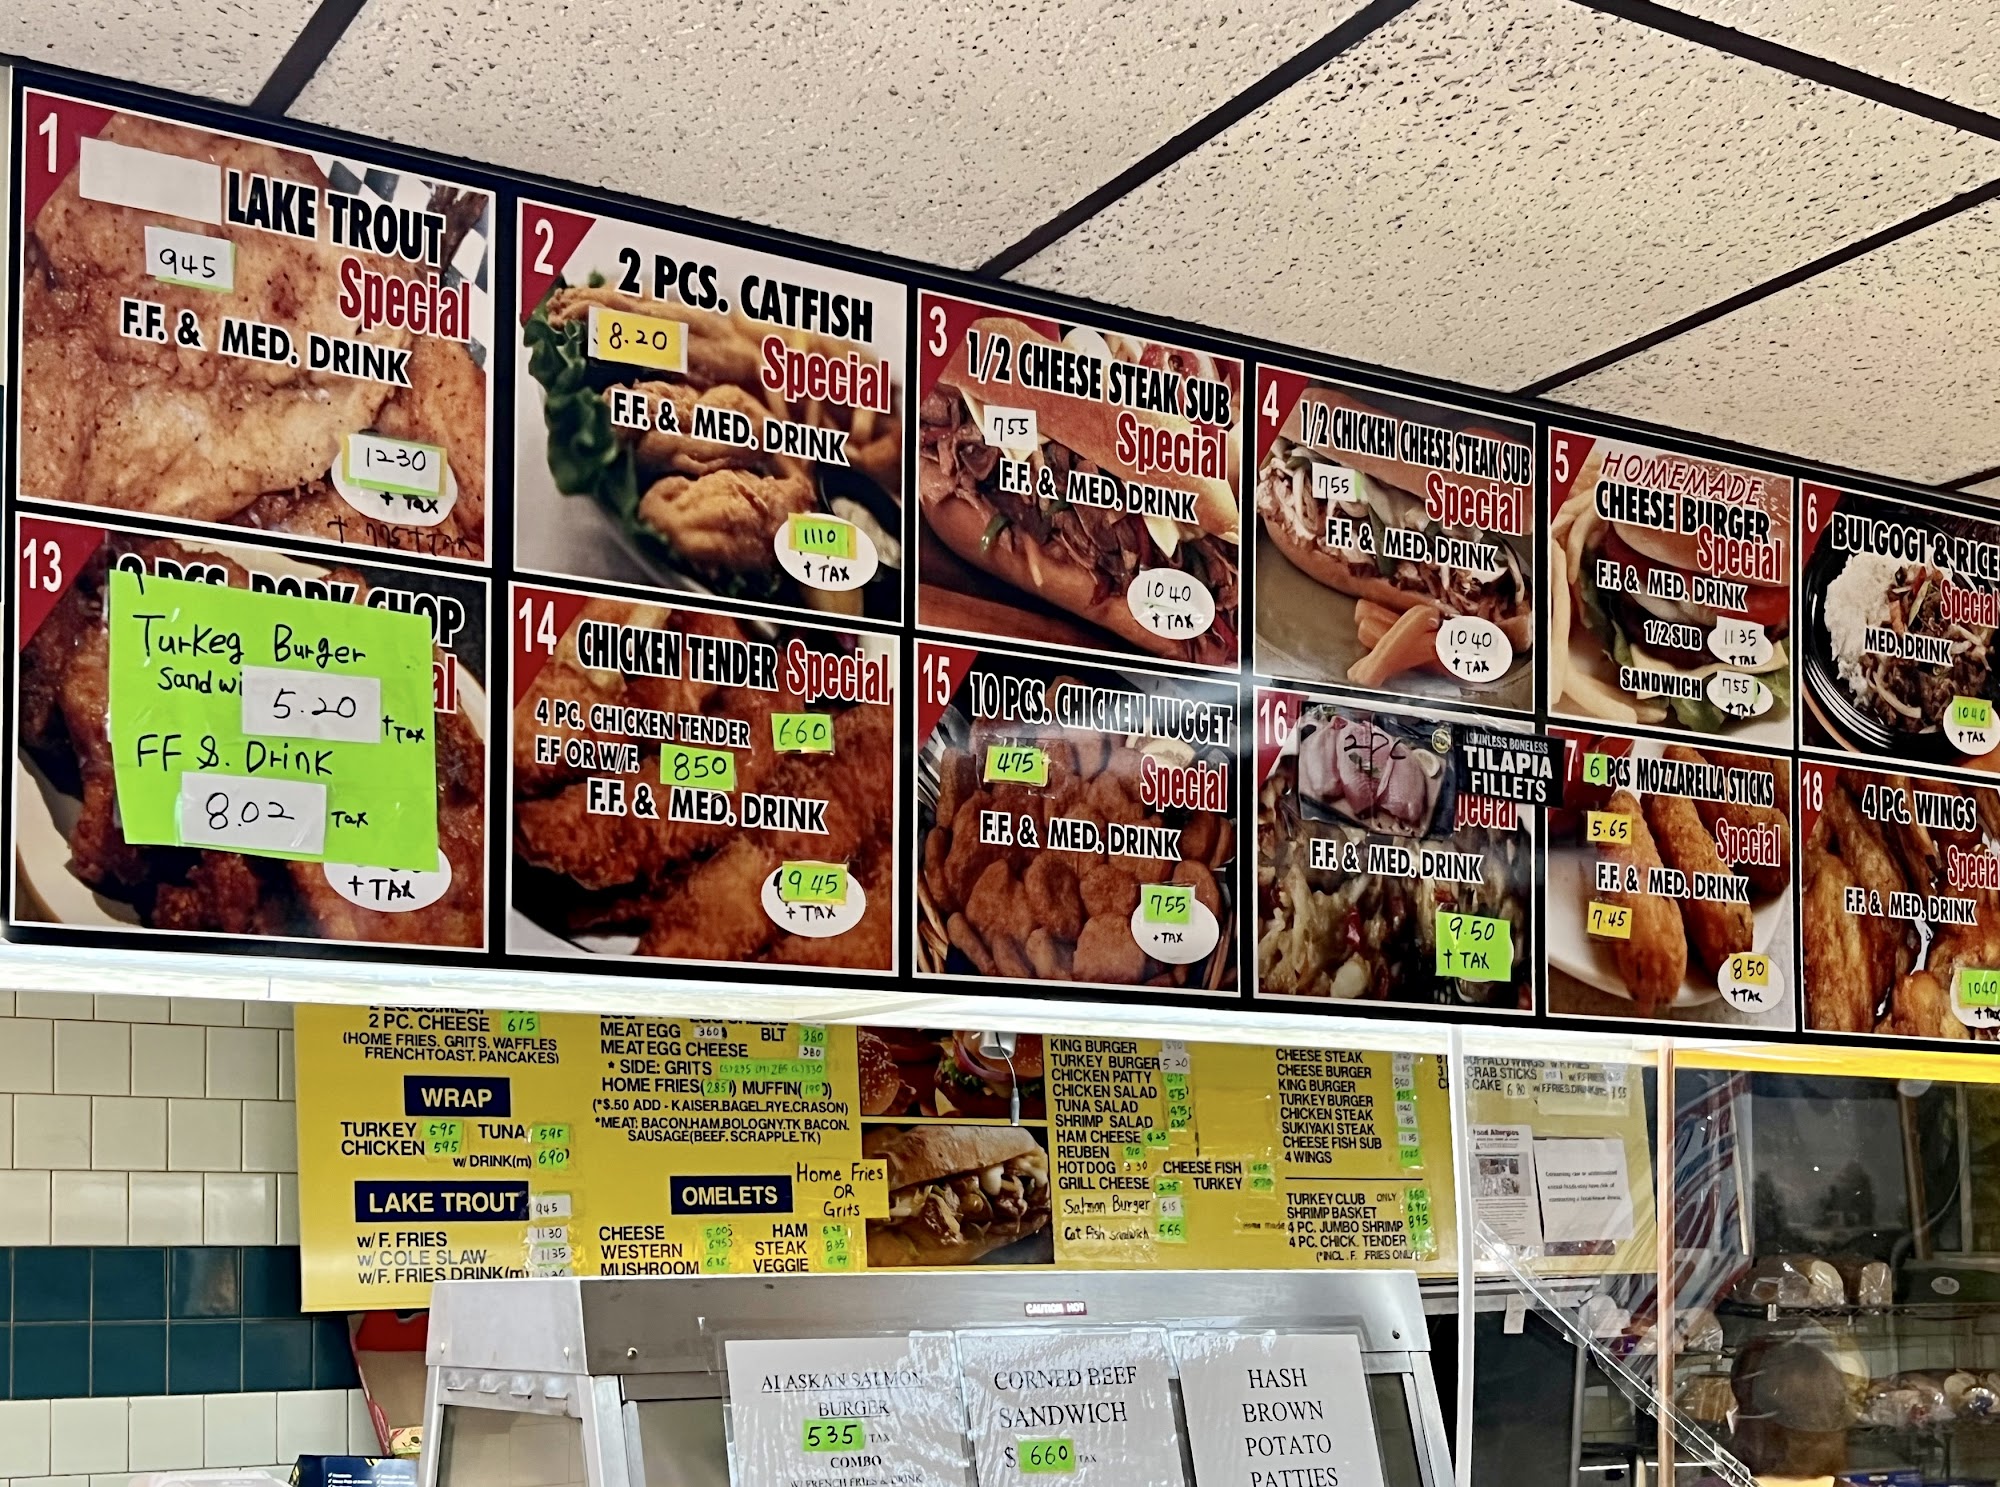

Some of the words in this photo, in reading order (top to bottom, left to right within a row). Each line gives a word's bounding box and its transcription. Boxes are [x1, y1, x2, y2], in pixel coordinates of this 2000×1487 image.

[39, 113, 57, 173] 1
[228, 171, 317, 239] LAKE
[326, 190, 445, 265] TROUT
[534, 219, 554, 276] 2
[160, 248, 216, 278] 945
[340, 258, 471, 341] Special
[619, 247, 641, 294] 2
[655, 254, 728, 312] PCS.
[741, 275, 873, 343] CATFISH
[610, 322, 667, 350] 8.20
[929, 306, 948, 358] 3
[221, 320, 299, 365] MED.
[311, 336, 412, 387] DRINK
[763, 338, 891, 413] Special
[967, 331, 1012, 384] 1/2
[1018, 342, 1102, 400] CHEESE
[1109, 360, 1181, 415] STEAK
[1185, 377, 1231, 425] SUB
[1262, 380, 1279, 427] 4
[1117, 413, 1228, 480] Special
[1300, 401, 1329, 448] 1/2
[1332, 407, 1397, 461] CHICKEN
[1400, 422, 1452, 470] CHEESE
[1454, 431, 1500, 480] STEAK
[1502, 442, 1532, 486] SUB
[366, 446, 427, 471] 1230
[1554, 440, 1569, 483] 5
[1601, 451, 1766, 506] HOMEMADE
[1596, 481, 1675, 531] CHEESE
[1681, 497, 1770, 545] BURGER
[1807, 492, 1818, 533] 6
[803, 527, 836, 546] 1110
[1832, 512, 1927, 563] BULGOGI
[1932, 533, 1951, 570] &
[1954, 537, 2000, 581] RICE
[1697, 524, 1782, 584] Special
[22, 540, 63, 594] 13
[1940, 578, 2000, 629] Special
[518, 597, 558, 656] 14
[1644, 620, 1670, 647] 1/2
[1671, 626, 1702, 652] SUB
[273, 624, 367, 669] Burger
[1864, 627, 1902, 659] MED.
[1903, 633, 1953, 667] DRINK
[578, 621, 682, 679] CHICKEN
[687, 637, 778, 692] TENDER
[786, 638, 891, 704] Special
[922, 653, 950, 706] 15
[1620, 666, 1703, 701] SANDWICH
[272, 689, 357, 721] 5.20
[970, 672, 1000, 719] 10
[1003, 677, 1051, 725] PCS.
[1056, 683, 1146, 735] CHICKEN
[1149, 695, 1233, 747] NUGGET
[535, 698, 549, 725] 4
[553, 702, 585, 730] PC.
[590, 706, 674, 741] CHICKEN
[678, 715, 751, 748] TENDER
[777, 720, 827, 745] 660
[1260, 698, 1287, 747] 16
[137, 734, 182, 771] FF
[246, 742, 333, 775] Drink
[1509, 738, 1550, 756] BONELESS
[673, 752, 727, 781] 850
[996, 753, 1035, 774] 475
[1463, 746, 1553, 780] TILAPIA
[1590, 757, 1600, 778] 6
[1141, 755, 1229, 812] Special
[1471, 771, 1547, 803] FILLETS
[1606, 757, 1631, 788] PCS
[1636, 758, 1727, 803] MOZZARELLA
[1728, 767, 1774, 809] STICKS
[1802, 770, 1823, 812] 18
[205, 791, 295, 830] 8.02
[1862, 784, 1877, 820] 4
[1880, 787, 1911, 824] PC.
[1913, 790, 1976, 832] WINGS
[1592, 819, 1628, 838] 5.65
[1150, 894, 1187, 917] 755
[1449, 916, 1495, 941] 9.50
[368, 1014, 380, 1028] 2
[384, 1014, 414, 1030] PC.
[418, 1015, 490, 1032] CHEESE
[507, 1018, 536, 1032] 615
[761, 1027, 787, 1042] BLT
[493, 1037, 557, 1051] WAFFLES
[646, 1041, 682, 1056] EGG
[685, 1042, 749, 1058] CHEESE
[1050, 1039, 1082, 1052] KING
[1085, 1040, 1137, 1054] BURGER
[1276, 1049, 1322, 1063] CHEESE
[1325, 1051, 1363, 1063] STEAK
[620, 1060, 660, 1075] SIDE:
[664, 1061, 713, 1076] GRITS
[1052, 1070, 1109, 1083] CHICKEN
[1113, 1071, 1152, 1084] PATTY
[1499, 1067, 1537, 1080] STICKS
[1472, 1079, 1502, 1091] CAKE
[420, 1086, 493, 1109] WRAP
[1055, 1100, 1092, 1113] TUNA
[1094, 1100, 1138, 1113] SALAD
[340, 1122, 417, 1138] TURKEY
[478, 1124, 526, 1139] TUNA
[1282, 1122, 1335, 1134] SUKIYAKI
[1337, 1123, 1375, 1135] STEAK
[340, 1140, 426, 1156] CHICKEN
[1057, 1145, 1110, 1158] REUBEN
[1331, 1137, 1358, 1149] FISH
[1360, 1137, 1382, 1149] SUB
[796, 1161, 843, 1183] Home
[851, 1162, 884, 1182] Fries
[1058, 1177, 1096, 1190] GRILL
[1099, 1177, 1150, 1190] CHEESE
[1193, 1177, 1243, 1190] TURKEY
[368, 1192, 434, 1213] LAKE
[440, 1191, 520, 1213] TROUT
[681, 1185, 778, 1206] OMELETS
[833, 1184, 855, 1199] OR
[1286, 1193, 1333, 1205] TURKEY
[1335, 1193, 1366, 1205] CLUB
[823, 1201, 861, 1218] Grits
[1112, 1197, 1150, 1216] Burger
[1332, 1207, 1377, 1219] BASKET
[599, 1225, 665, 1241] CHEESE
[772, 1224, 808, 1237] HAM
[1319, 1220, 1359, 1233] JUMBO
[1362, 1221, 1404, 1233] SHRIMP
[397, 1232, 448, 1248] FRIES
[601, 1243, 683, 1259] WESTERN
[755, 1241, 808, 1255] STEAK
[1363, 1235, 1407, 1247] TENDER
[379, 1250, 431, 1266] COLE
[436, 1249, 487, 1265] SLAW
[753, 1258, 809, 1273] VEGGIE
[994, 1368, 1081, 1391] CORNED
[1087, 1366, 1138, 1387] BEEF
[1248, 1368, 1308, 1389] HASH
[818, 1400, 890, 1418] BURGER
[999, 1401, 1128, 1429] SANDWICH
[1242, 1401, 1324, 1423] BROWN
[807, 1424, 858, 1447] 535
[1245, 1433, 1332, 1458] POTATO
[830, 1455, 882, 1469] COMBO
[1029, 1445, 1069, 1466] 660
[1251, 1467, 1339, 1487] PATTIES
